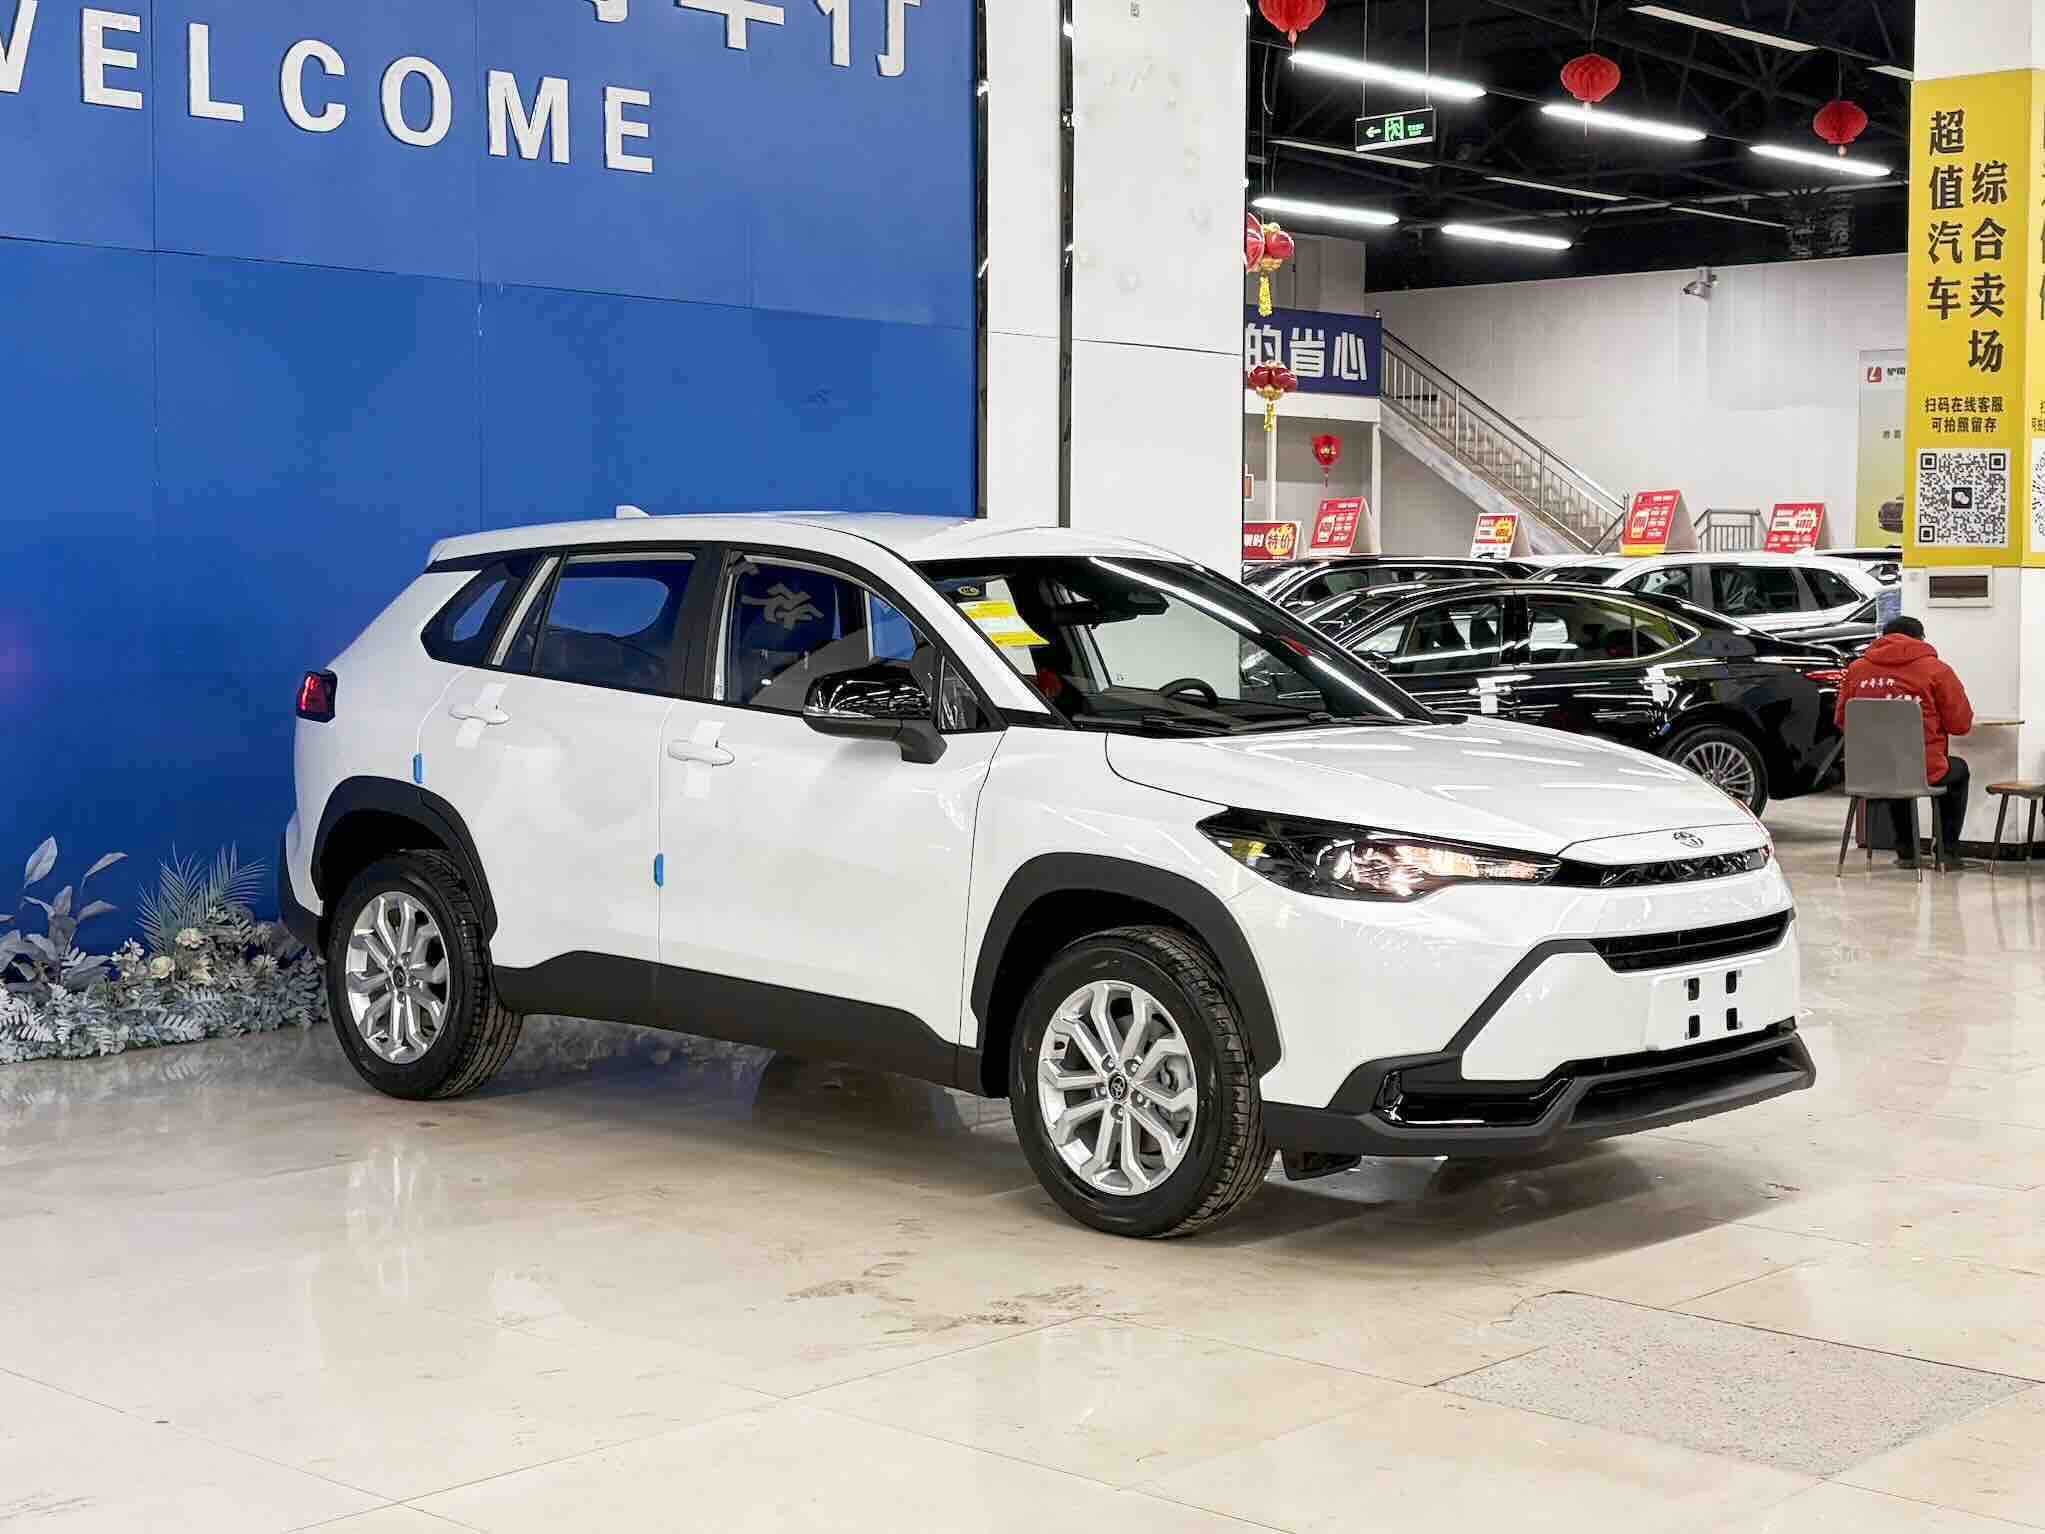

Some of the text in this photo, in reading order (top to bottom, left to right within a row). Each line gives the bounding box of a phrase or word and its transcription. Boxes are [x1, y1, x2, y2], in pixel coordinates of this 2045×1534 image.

[1927, 109, 1965, 321] 超值汽车
[1968, 160, 2008, 373] 综合卖场
[1925, 396, 2003, 413] 扫码在线客服
[1931, 417, 1997, 432] 可拍照留存
